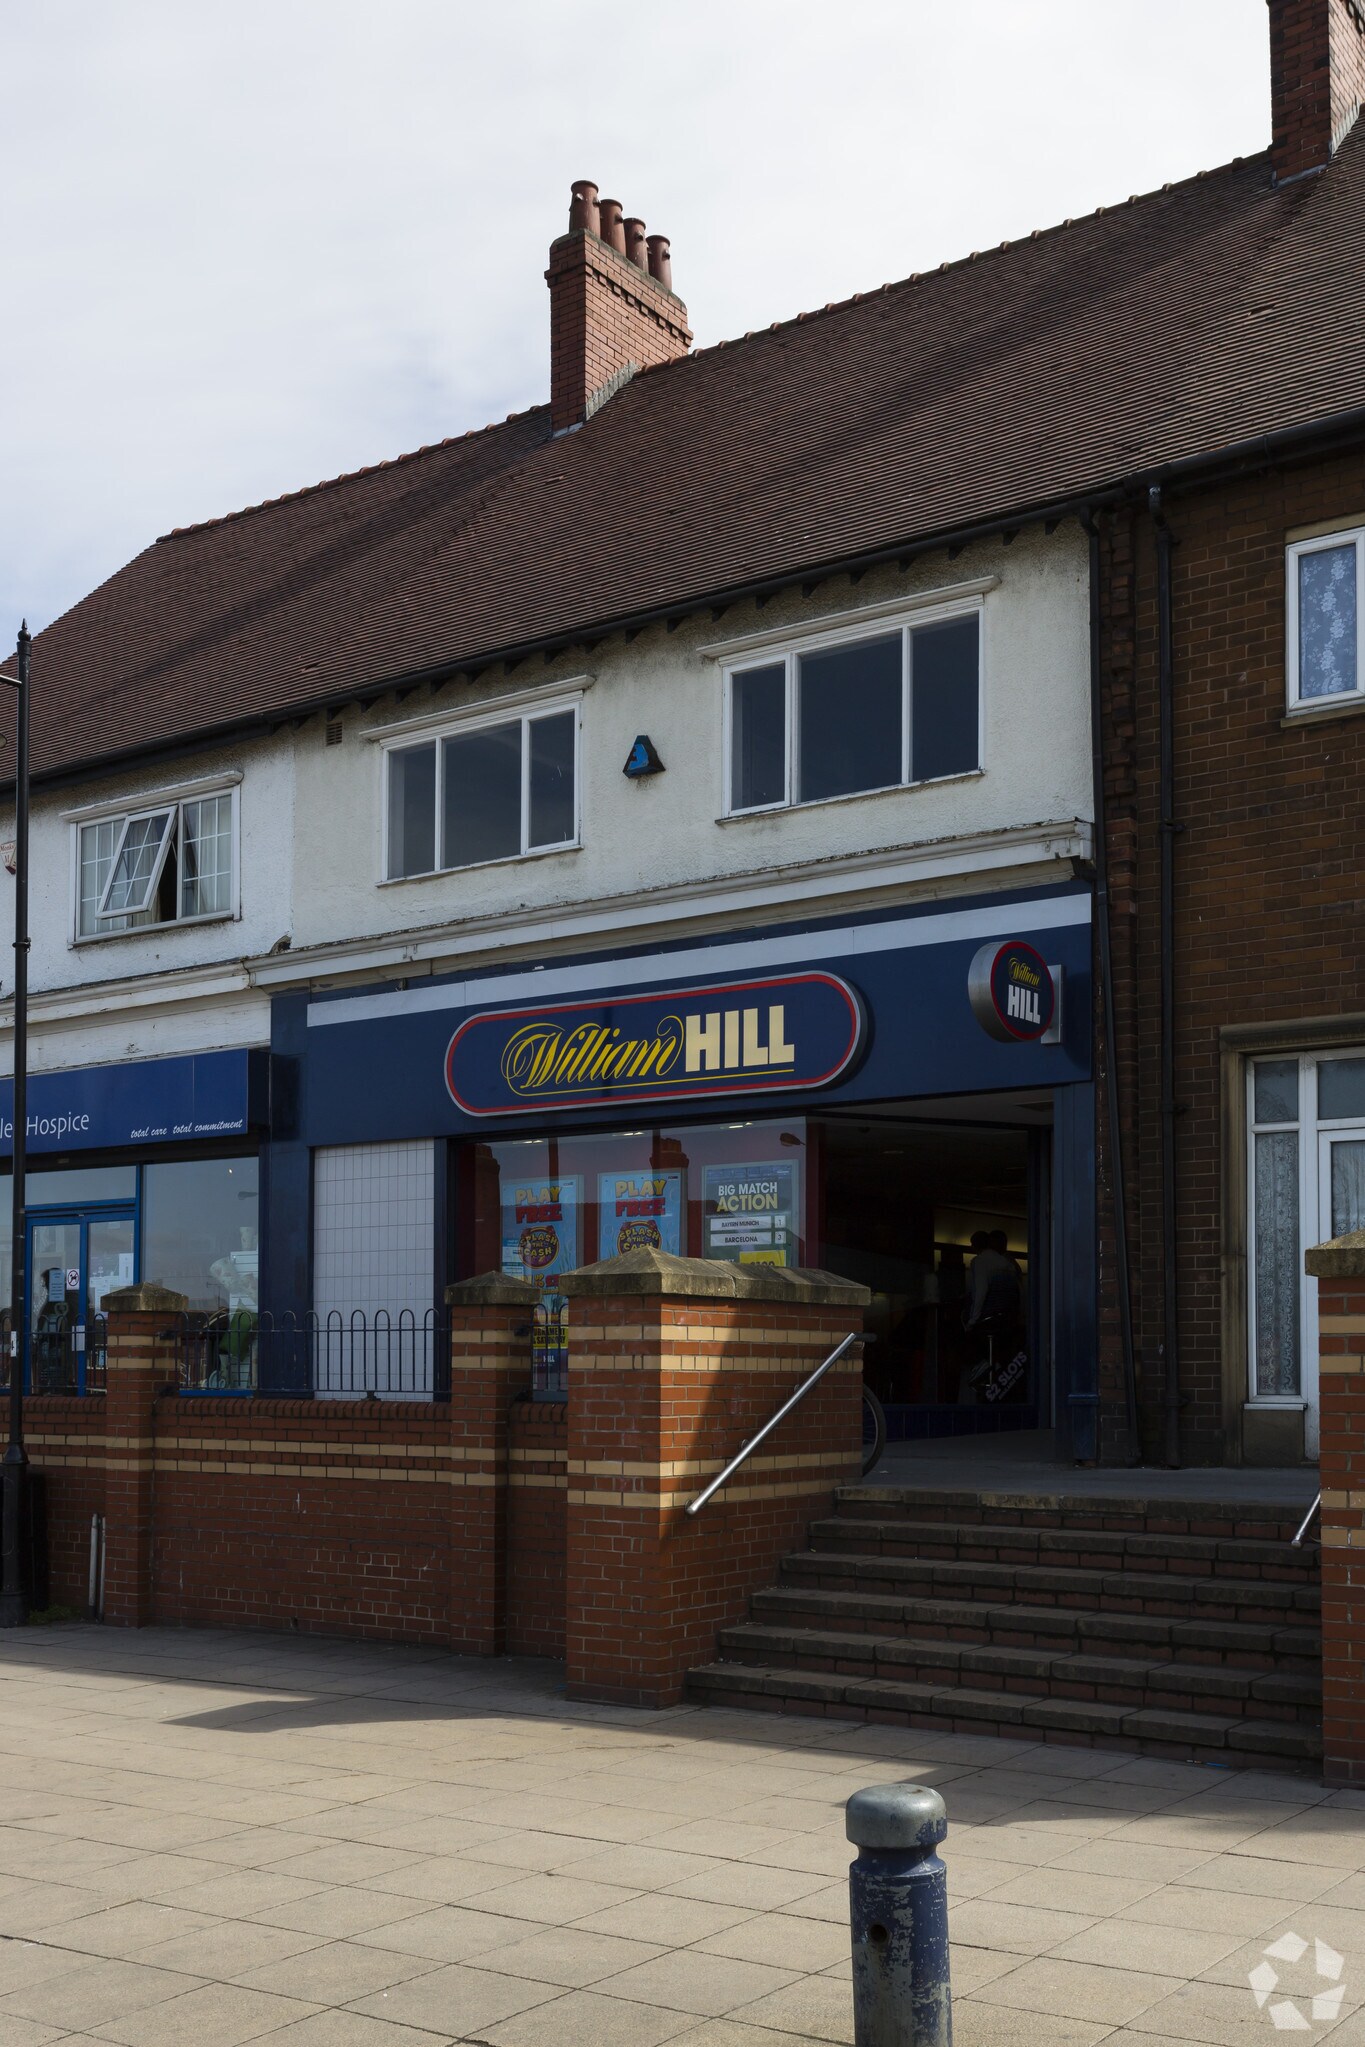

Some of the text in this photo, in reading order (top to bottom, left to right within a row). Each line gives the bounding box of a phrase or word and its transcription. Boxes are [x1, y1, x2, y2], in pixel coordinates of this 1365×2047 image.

[1008, 957, 1041, 989] William
[1007, 984, 1041, 1025] HILL
[500, 1004, 795, 1096] William HILL
[25, 1111, 90, 1139] Hospice
[130, 1118, 244, 1139] total care total commitment
[515, 1186, 563, 1205] PLAY
[615, 1178, 667, 1199] PLAY
[718, 1181, 778, 1197] BIG MATCH
[515, 1203, 563, 1224] FREE
[615, 1197, 666, 1218] FREE
[716, 1193, 778, 1213] ACTION
[520, 1230, 559, 1247] SPLASH
[619, 1226, 660, 1240] SPLASH
[523, 1247, 553, 1257] CASH
[985, 1351, 1028, 1402] £2 SLOTS
